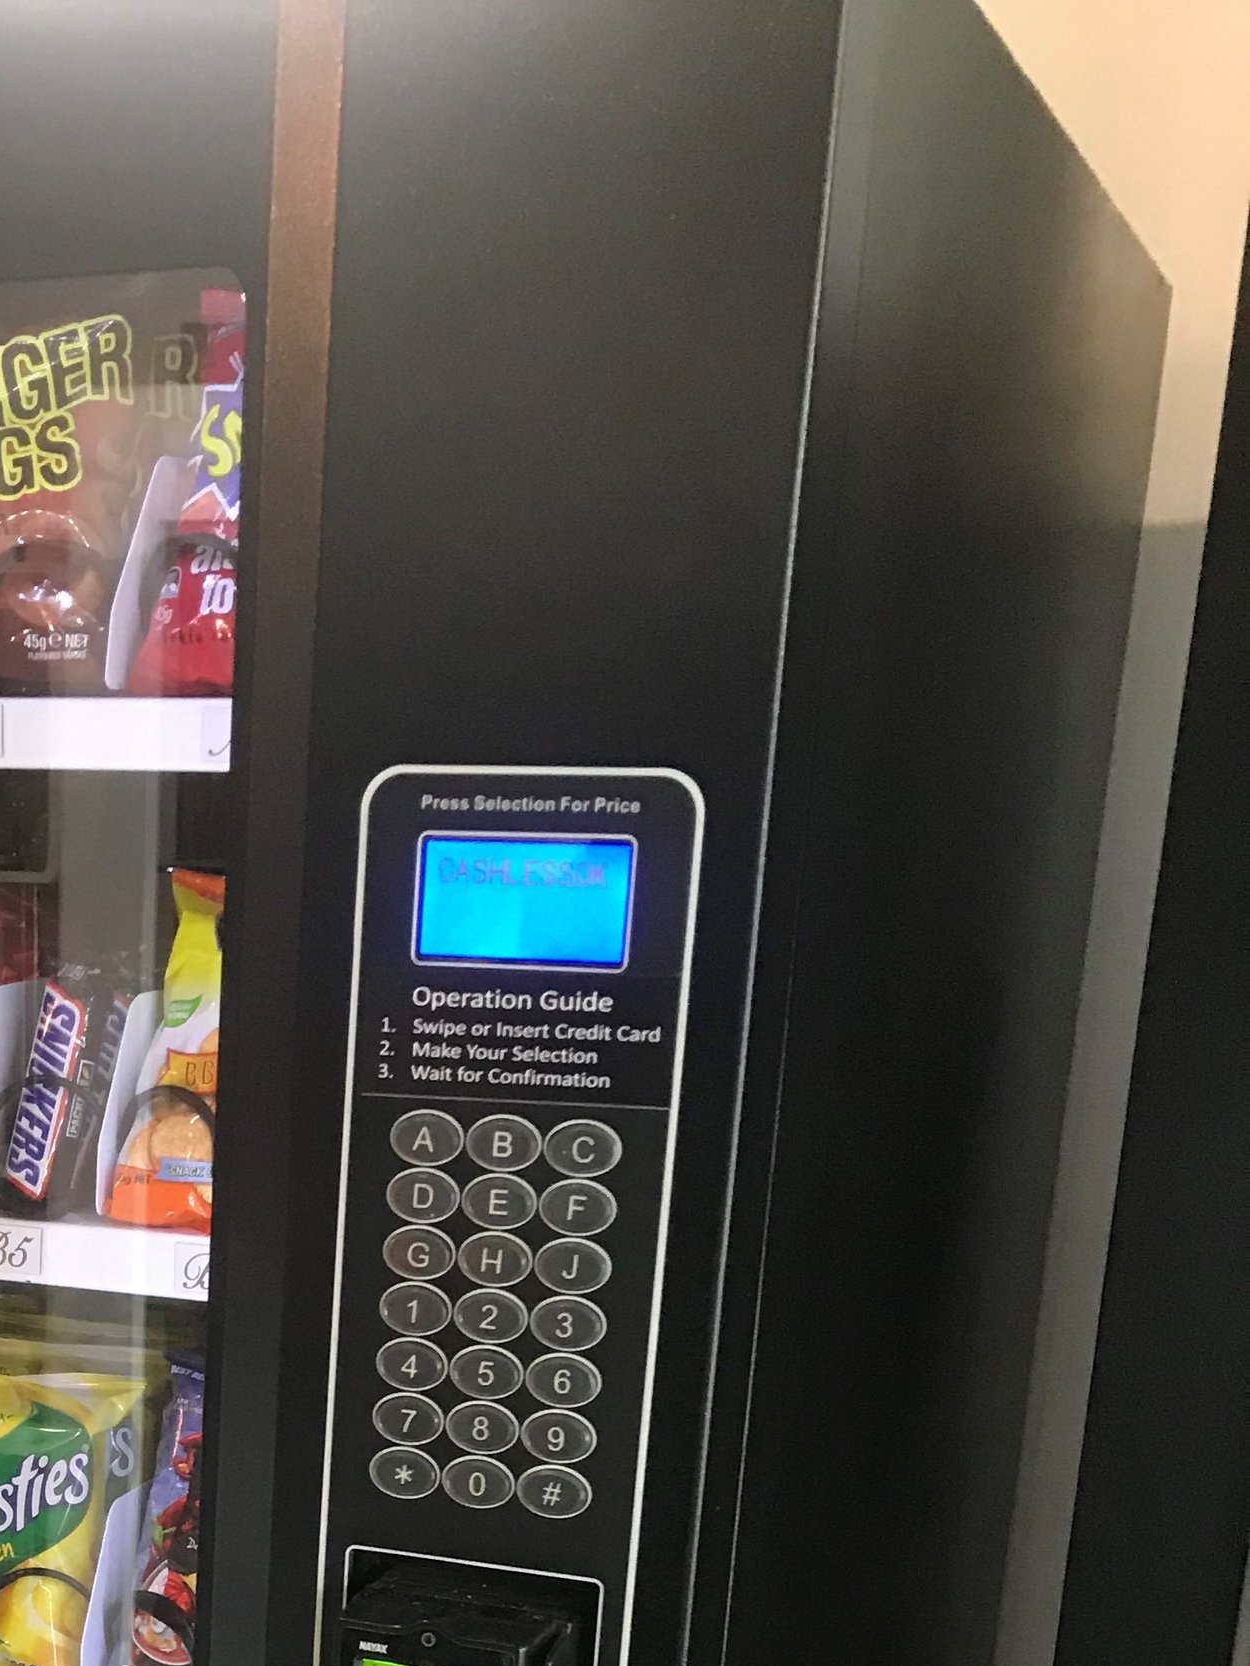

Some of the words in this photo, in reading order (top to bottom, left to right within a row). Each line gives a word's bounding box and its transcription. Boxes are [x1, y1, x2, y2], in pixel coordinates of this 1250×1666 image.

[421, 794, 469, 811] Press
[473, 795, 556, 813] Selection
[560, 796, 590, 813] For
[594, 797, 641, 814] Price
[412, 986, 533, 1012] Operation
[540, 990, 614, 1013] Guide
[381, 1016, 397, 1034] 1.
[413, 1018, 467, 1039] Swipe
[471, 1024, 492, 1038] or
[496, 1022, 550, 1040] Insert
[554, 1023, 612, 1042] Credit
[617, 1025, 662, 1044] Card
[379, 1040, 395, 1056] 2.
[412, 1041, 462, 1060] Make
[466, 1043, 507, 1062] Your
[511, 1045, 598, 1066] Selection
[378, 1063, 394, 1080] 3.
[411, 1064, 452, 1082] Wait
[457, 1066, 484, 1083] for
[488, 1067, 611, 1090] Confirmation
[412, 1126, 434, 1153] A
[492, 1131, 513, 1158] B
[571, 1136, 595, 1164] C
[412, 1183, 434, 1209] D
[488, 1189, 509, 1216] E
[566, 1195, 588, 1221] F
[407, 1242, 430, 1267] G
[480, 1247, 503, 1275] H
[561, 1254, 580, 1280] J
[407, 1299, 419, 1324] 1
[479, 1304, 499, 1330] 2
[555, 1312, 573, 1338] 3
[400, 1354, 418, 1379] 4
[477, 1361, 495, 1386] 5
[553, 1369, 572, 1394] 6
[401, 1409, 417, 1433] 7
[471, 1416, 489, 1441] 8
[547, 1427, 565, 1452] 9
[469, 1472, 486, 1497] 0
